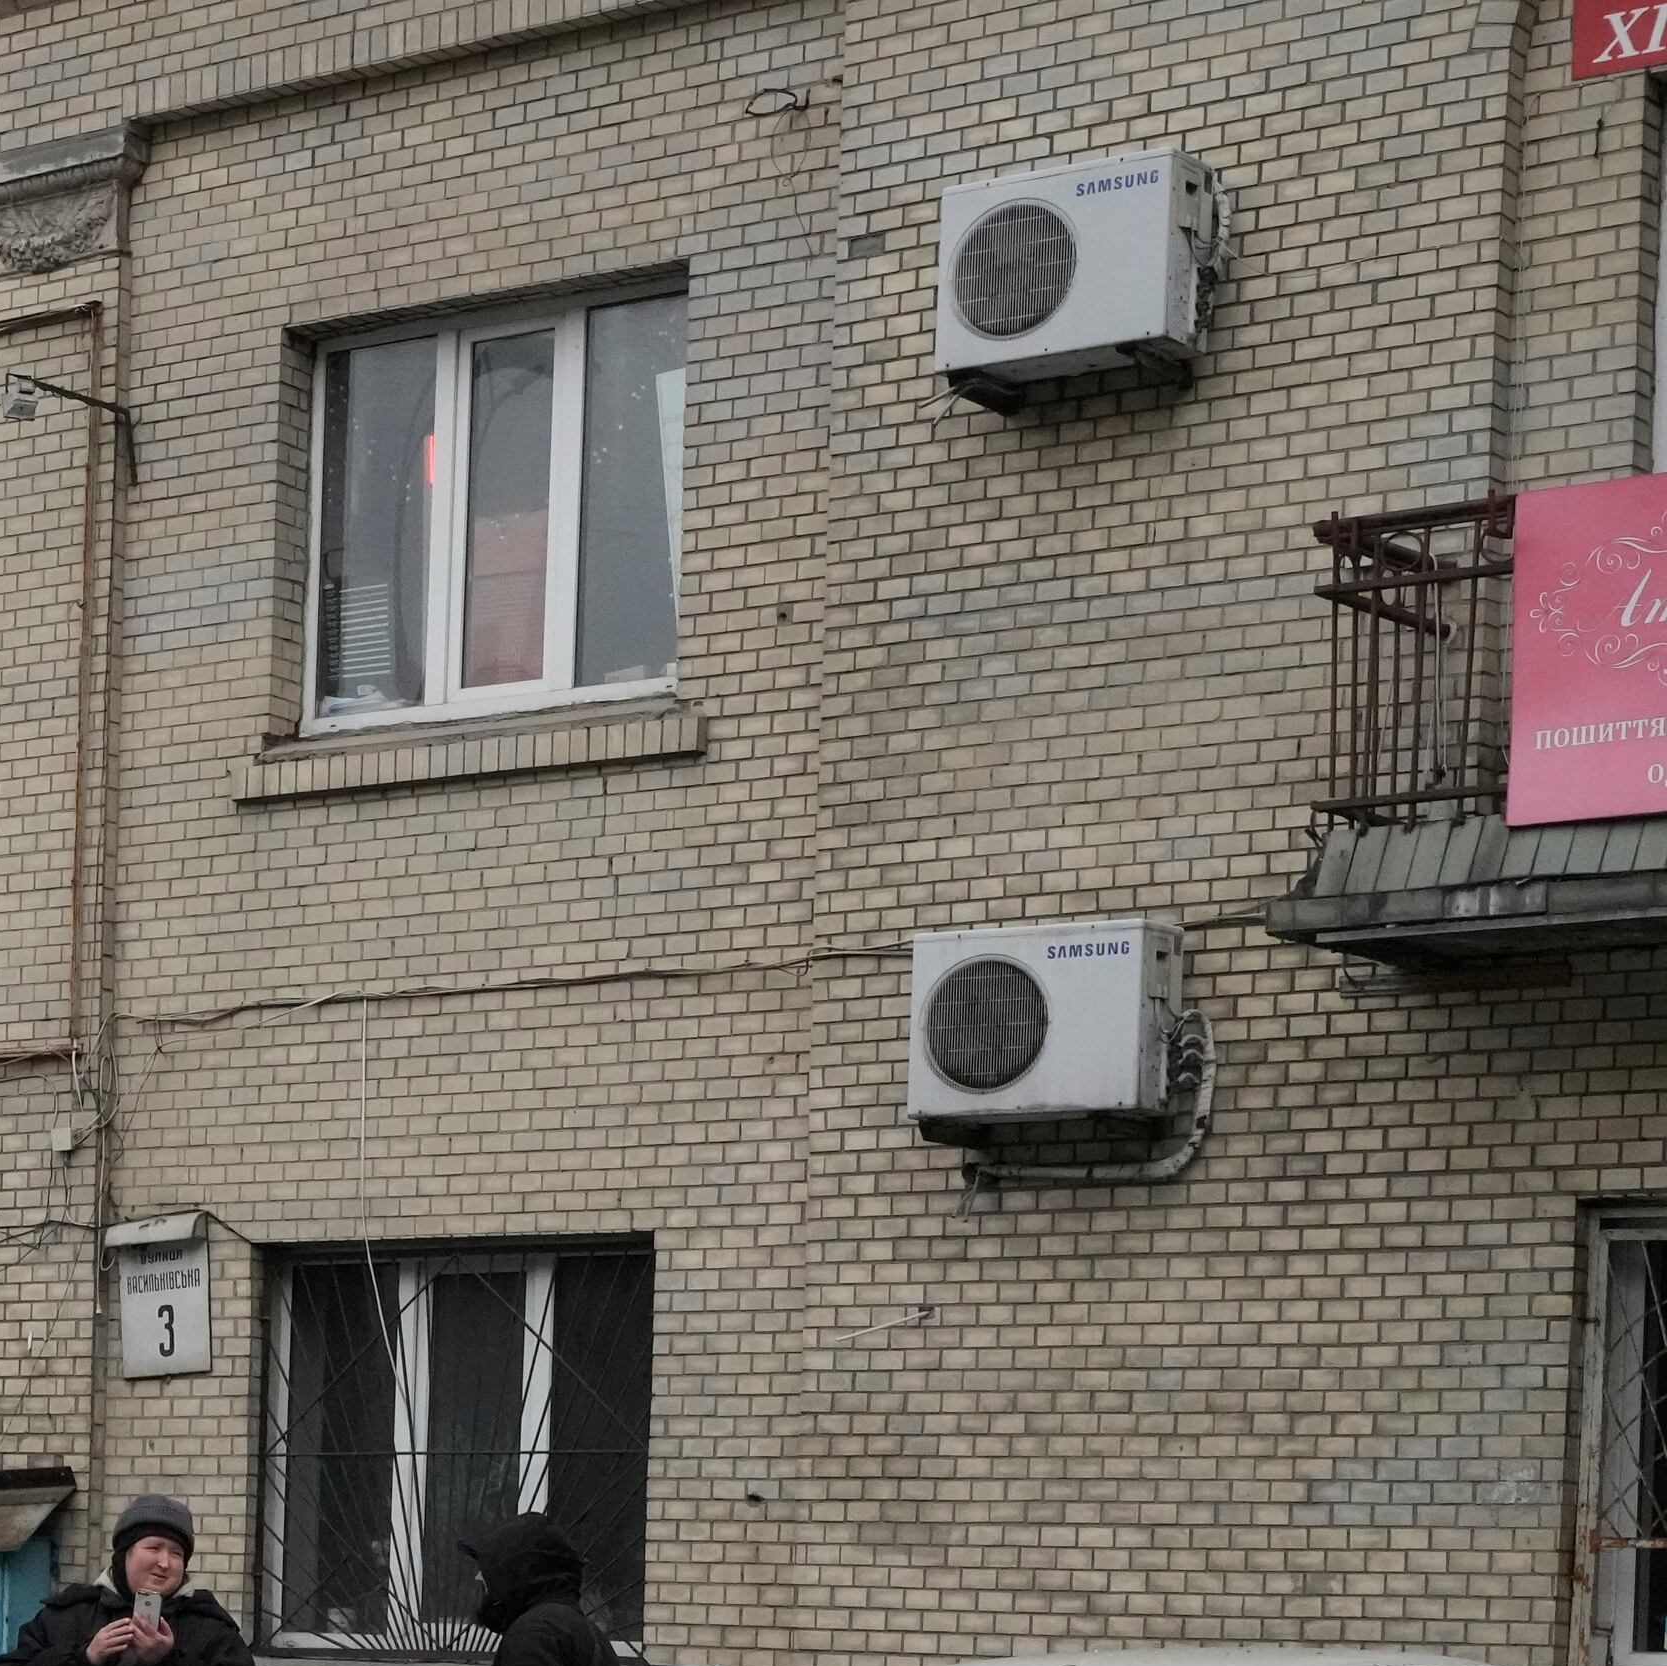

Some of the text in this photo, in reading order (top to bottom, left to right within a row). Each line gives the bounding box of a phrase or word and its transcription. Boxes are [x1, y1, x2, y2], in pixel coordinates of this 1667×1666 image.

[1075, 169, 1160, 197] SAMSUNG
[1047, 940, 1131, 960] SAMSUNG
[127, 1267, 201, 1295] ВАСИЛЬКІВСЬКА
[157, 1304, 175, 1357] 3
